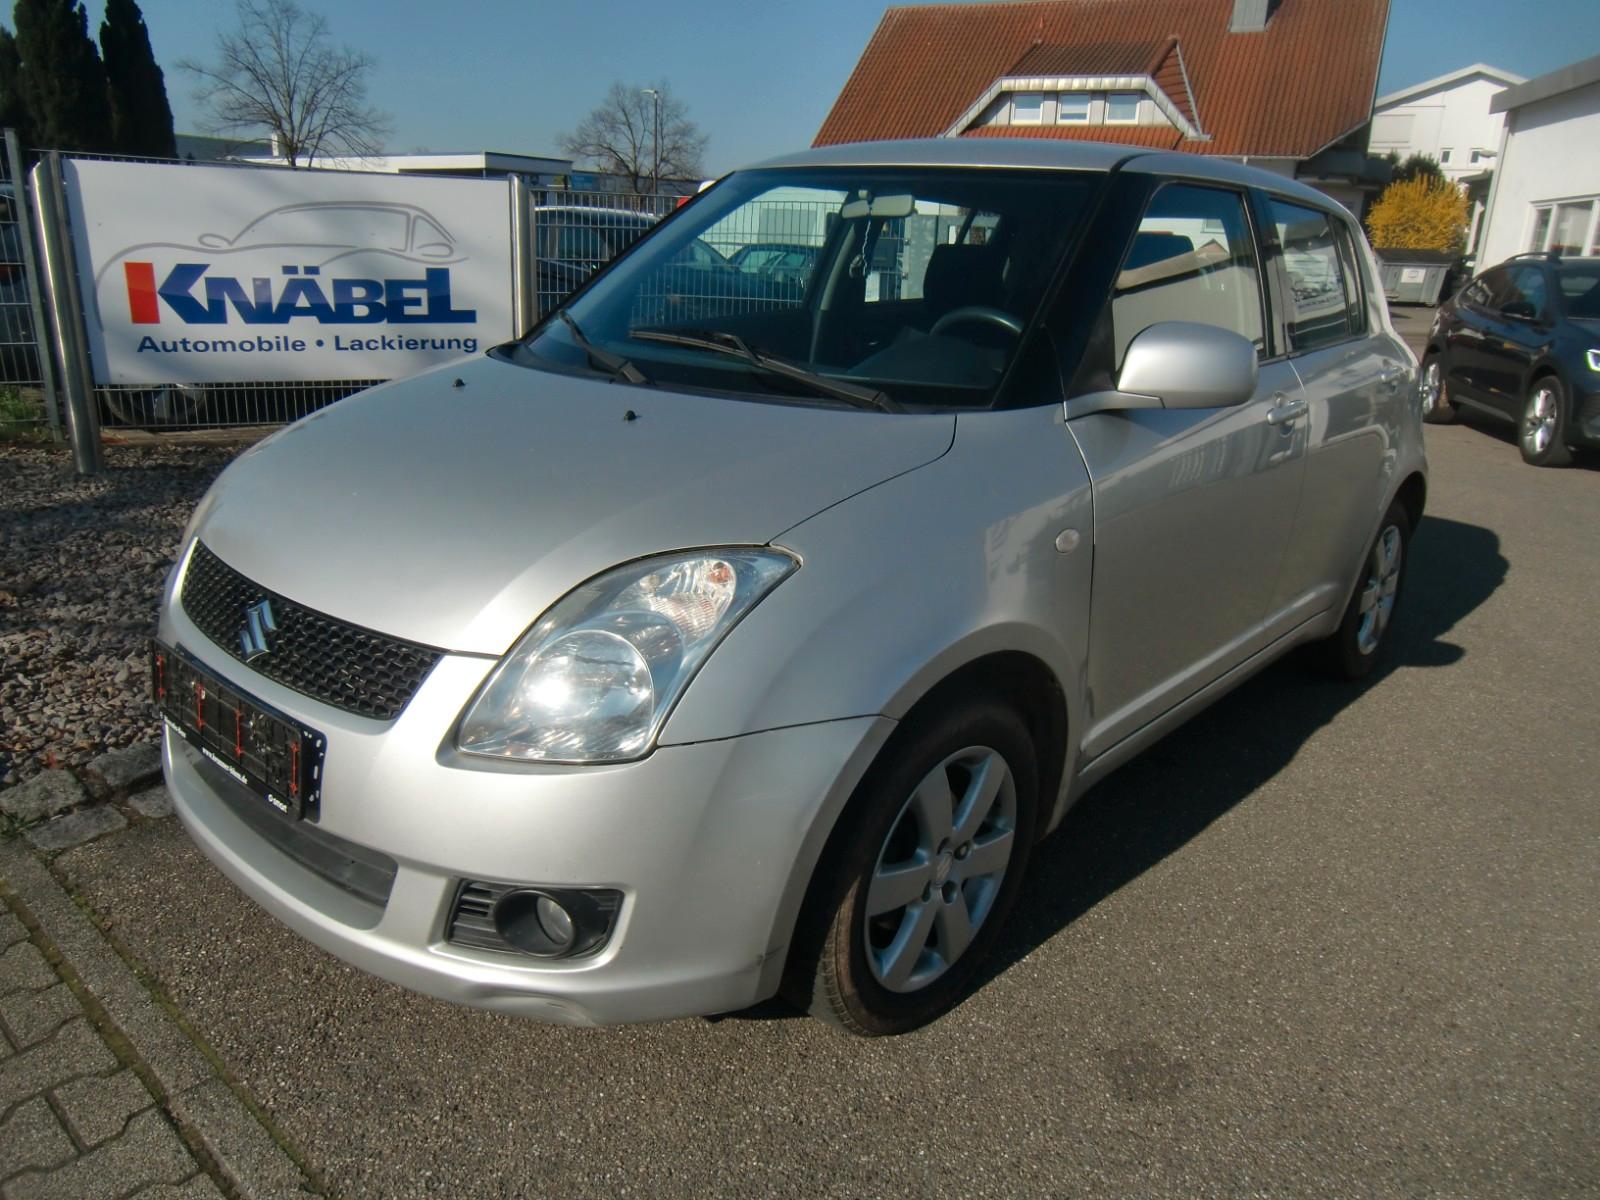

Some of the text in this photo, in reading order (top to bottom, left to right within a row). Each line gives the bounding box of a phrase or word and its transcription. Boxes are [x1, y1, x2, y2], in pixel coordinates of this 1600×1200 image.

[124, 262, 477, 324] KNÄBEL
[137, 335, 478, 354] Automobile Lackierung
